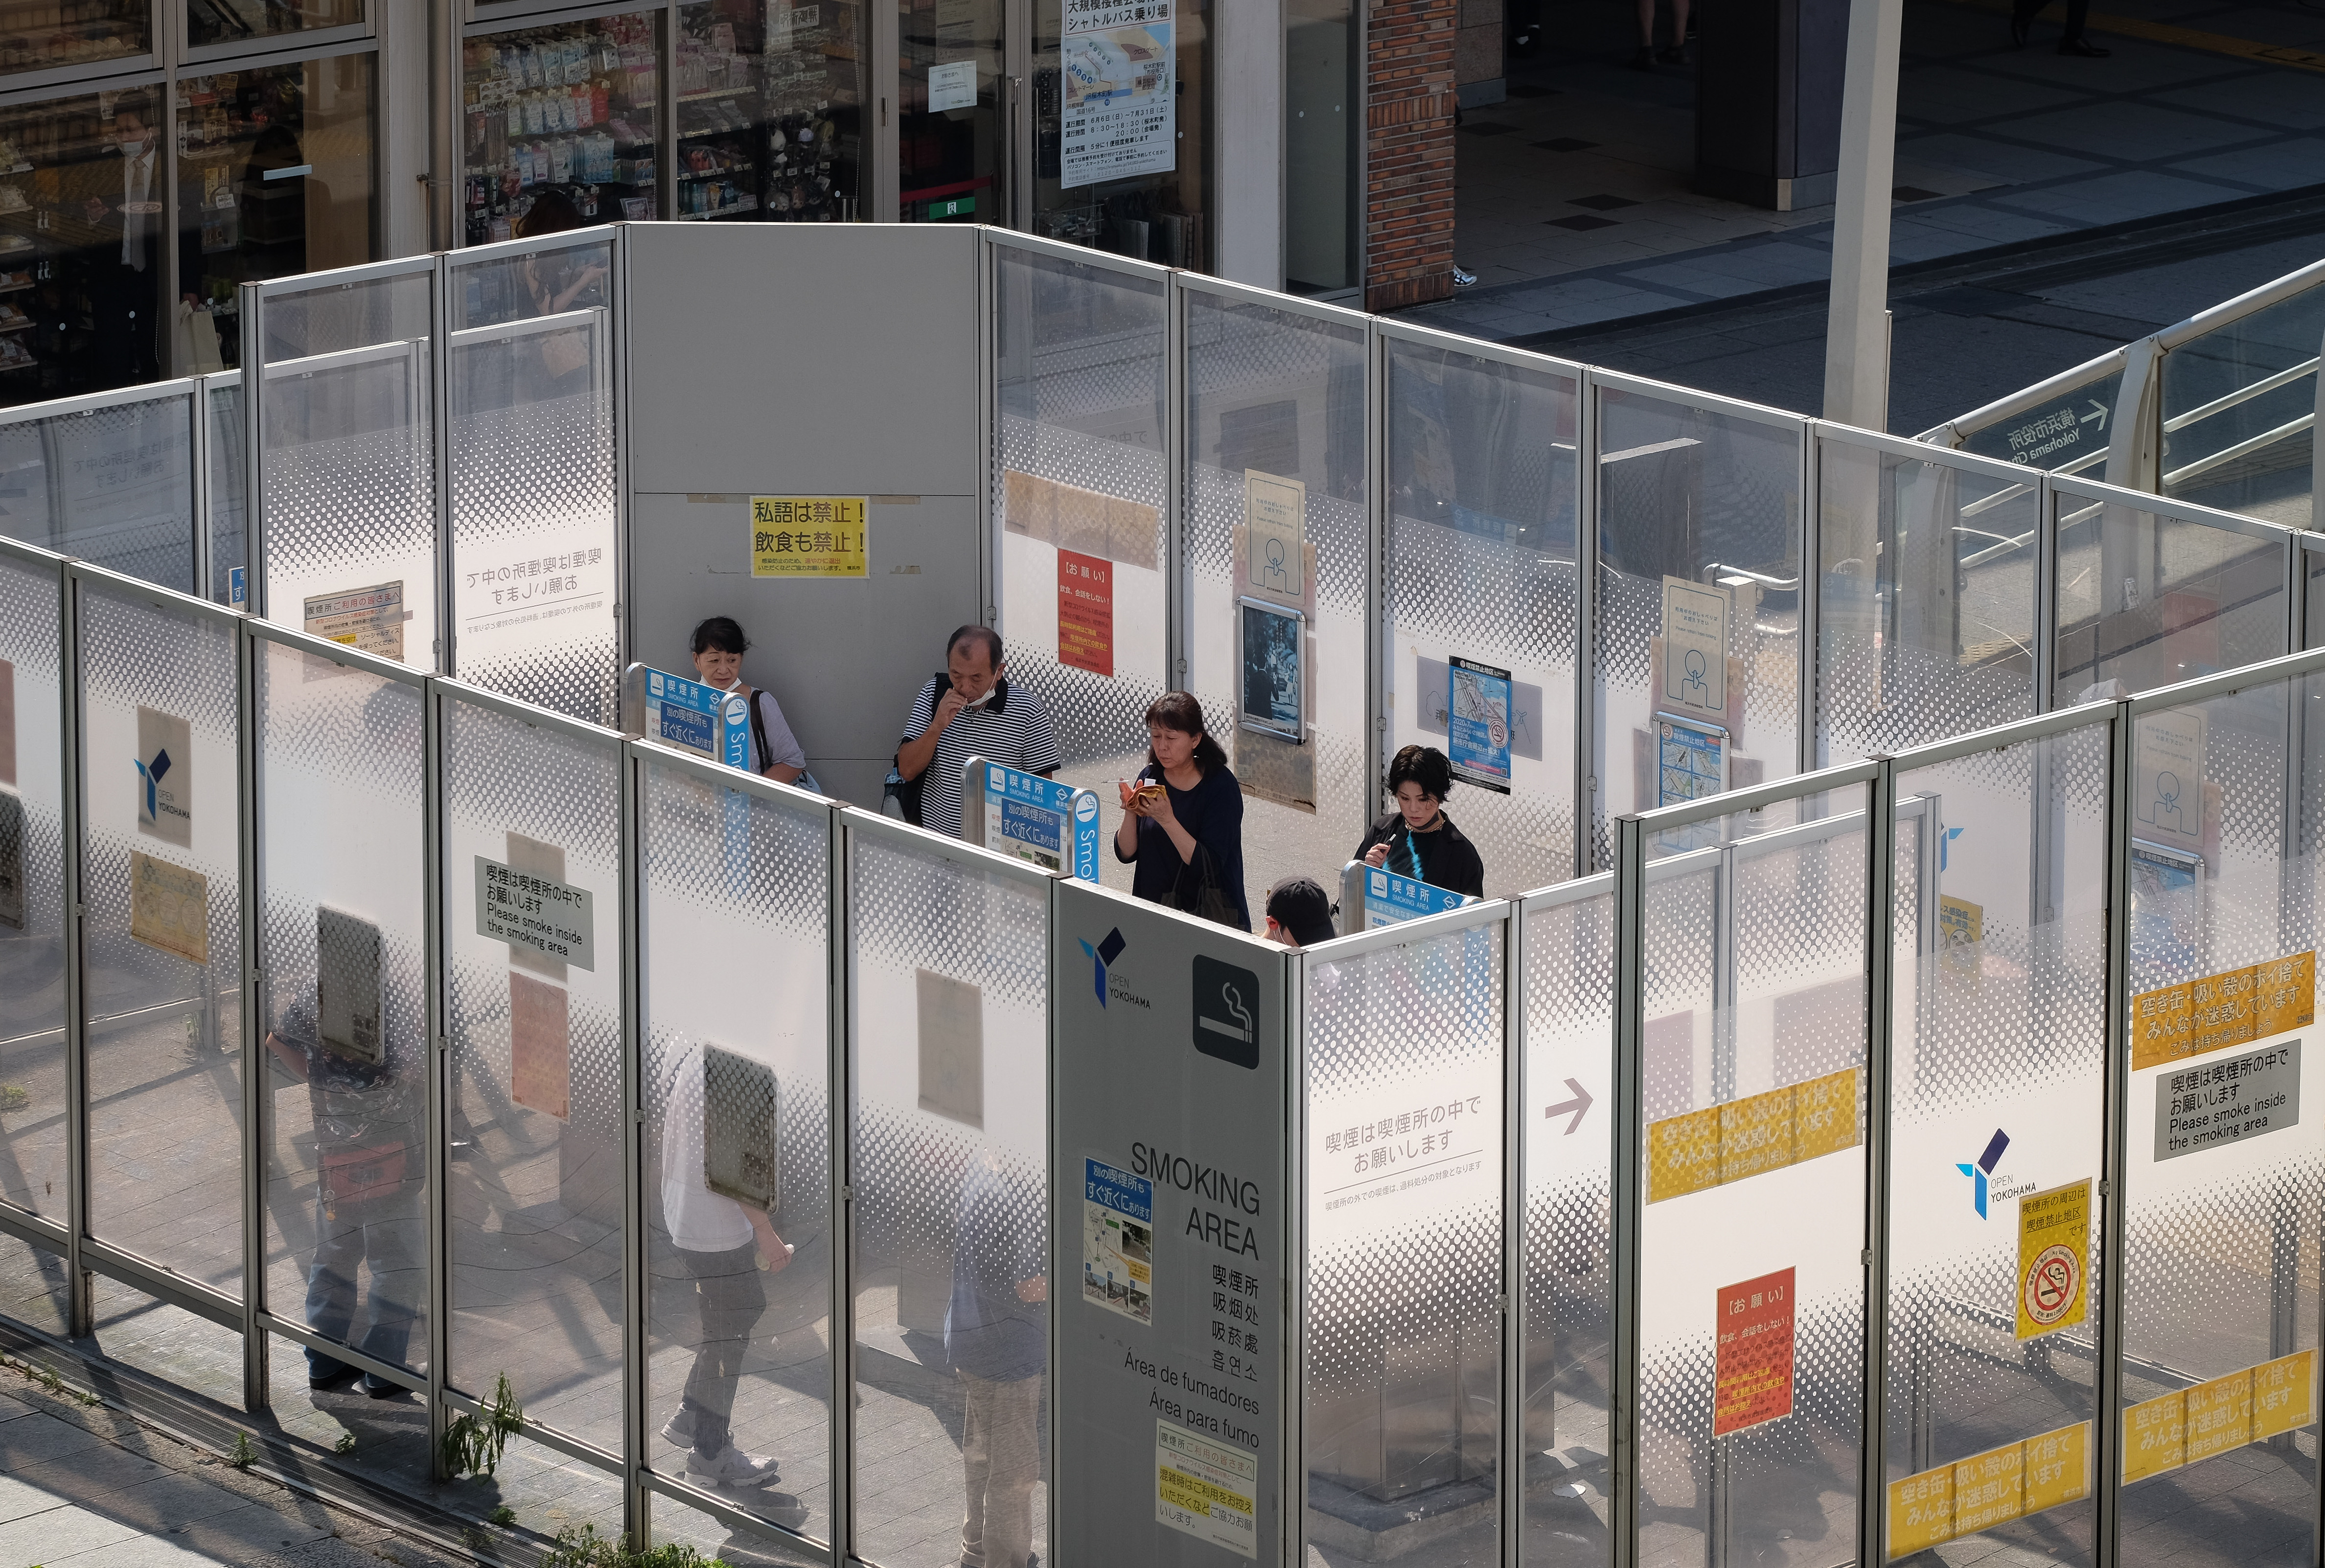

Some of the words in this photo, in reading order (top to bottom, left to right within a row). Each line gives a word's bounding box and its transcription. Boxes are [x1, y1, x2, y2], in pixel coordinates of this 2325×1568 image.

[1069, 4, 1168, 31] シャトルバス乗り場
[1085, 90, 1113, 100] JR桜木町駅
[755, 502, 864, 523] 私語は禁止!
[755, 531, 864, 553] 飲食も禁止!
[307, 591, 399, 616] 喫煙所ご利用の皆さまへ
[667, 679, 699, 700] 喫煙所
[667, 693, 687, 704] SMOKING
[688, 699, 699, 708] AREA
[662, 720, 713, 750] すぐ近くにあります
[667, 707, 708, 728] 別の喫煙所も
[158, 789, 174, 803] OPEN
[1009, 774, 1044, 795] 喫煙所
[1010, 788, 1030, 799] SMOKING
[158, 801, 191, 820] YOKOHAMA
[1008, 804, 1054, 826] 別の喫煙所も
[1003, 818, 1059, 849] すぐ近くにあります
[486, 864, 582, 909] 喫煙は喫煙所の中で
[486, 882, 543, 914] お願いします
[1392, 879, 1430, 903] 喫煙所
[1392, 894, 1415, 907] SMOKING
[1416, 902, 1429, 912] AREA
[487, 902, 519, 924] Please
[523, 917, 552, 935] smoke
[555, 923, 582, 945] inside
[487, 919, 503, 935] the
[506, 927, 545, 951] smoking
[548, 941, 568, 957] area
[1109, 973, 1129, 989] OPEN
[1109, 987, 1151, 1010] YOKOHAMA
[2141, 958, 2306, 1019] 空き缶・吸い殻のポイ捨て
[2146, 985, 2301, 1040] みんなが迷惑しています
[2170, 1018, 2272, 1057] ごみは持ち帰りましょう
[2171, 1048, 2288, 1095] 喫煙は喫煙所の中で
[1662, 1078, 1843, 1147] 空き缶・吸い殻のポイ捨て
[2170, 1082, 2240, 1116] お願いします
[2170, 1114, 2209, 1134] Please
[2213, 1100, 2250, 1122] smoke
[2255, 1091, 2286, 1113] inside
[1325, 1095, 1481, 1154] 喫煙は喫煙所の中で
[1668, 1106, 1837, 1169] みんなが迷惑しています
[2168, 1135, 2188, 1151] the
[2193, 1122, 2240, 1146] smoking
[2243, 1114, 2268, 1132] area
[1354, 1129, 1453, 1174] お願いします
[1694, 1142, 1807, 1184] ごみは持ち帰りましょう
[1093, 1165, 1145, 1193] 別の喫煙所も
[1131, 1142, 1260, 1217] SMOKING
[1325, 1160, 1482, 1212] 喫煙所の外での喫煙は、過料処分の対象となります
[1990, 1174, 2014, 1189] OPEN
[1990, 1182, 2037, 1203] YOKOHAMA
[1087, 1181, 1150, 1220] すぐ近くにあります
[2022, 1187, 2086, 1216] 喫煙所の周辺は
[1185, 1206, 1259, 1261] AREA
[2026, 1207, 2081, 1232] 喫煙禁止地区
[2070, 1222, 2086, 1236] です
[1213, 1264, 1259, 1299] 喫煙所
[1213, 1291, 1259, 1326] 吸烟处
[1212, 1320, 1259, 1355] 吸菸處
[1124, 1346, 1156, 1379] Área
[1160, 1365, 1178, 1386] de
[1182, 1372, 1260, 1415] fumadores
[1212, 1349, 1258, 1382] 흡연소
[2135, 1360, 2299, 1431] 空き缶・吸い殻のポイ捨て
[1149, 1386, 1182, 1419] Área
[1186, 1408, 1219, 1434] para
[1222, 1418, 1260, 1449] fumo
[2140, 1386, 2293, 1451] みんなが迷惑しています
[1161, 1432, 1253, 1475] 喫煙所ご利用の皆さまへ
[1901, 1432, 2072, 1506] 空き缶・吸い殻のポイ捨て
[1159, 1468, 1253, 1514] 混雑時はご利用をお控え
[1906, 1459, 2066, 1527] みんなが迷惑しています
[1160, 1486, 1253, 1532] いただくなどご協力お願
[1160, 1504, 1196, 1528] いします。
